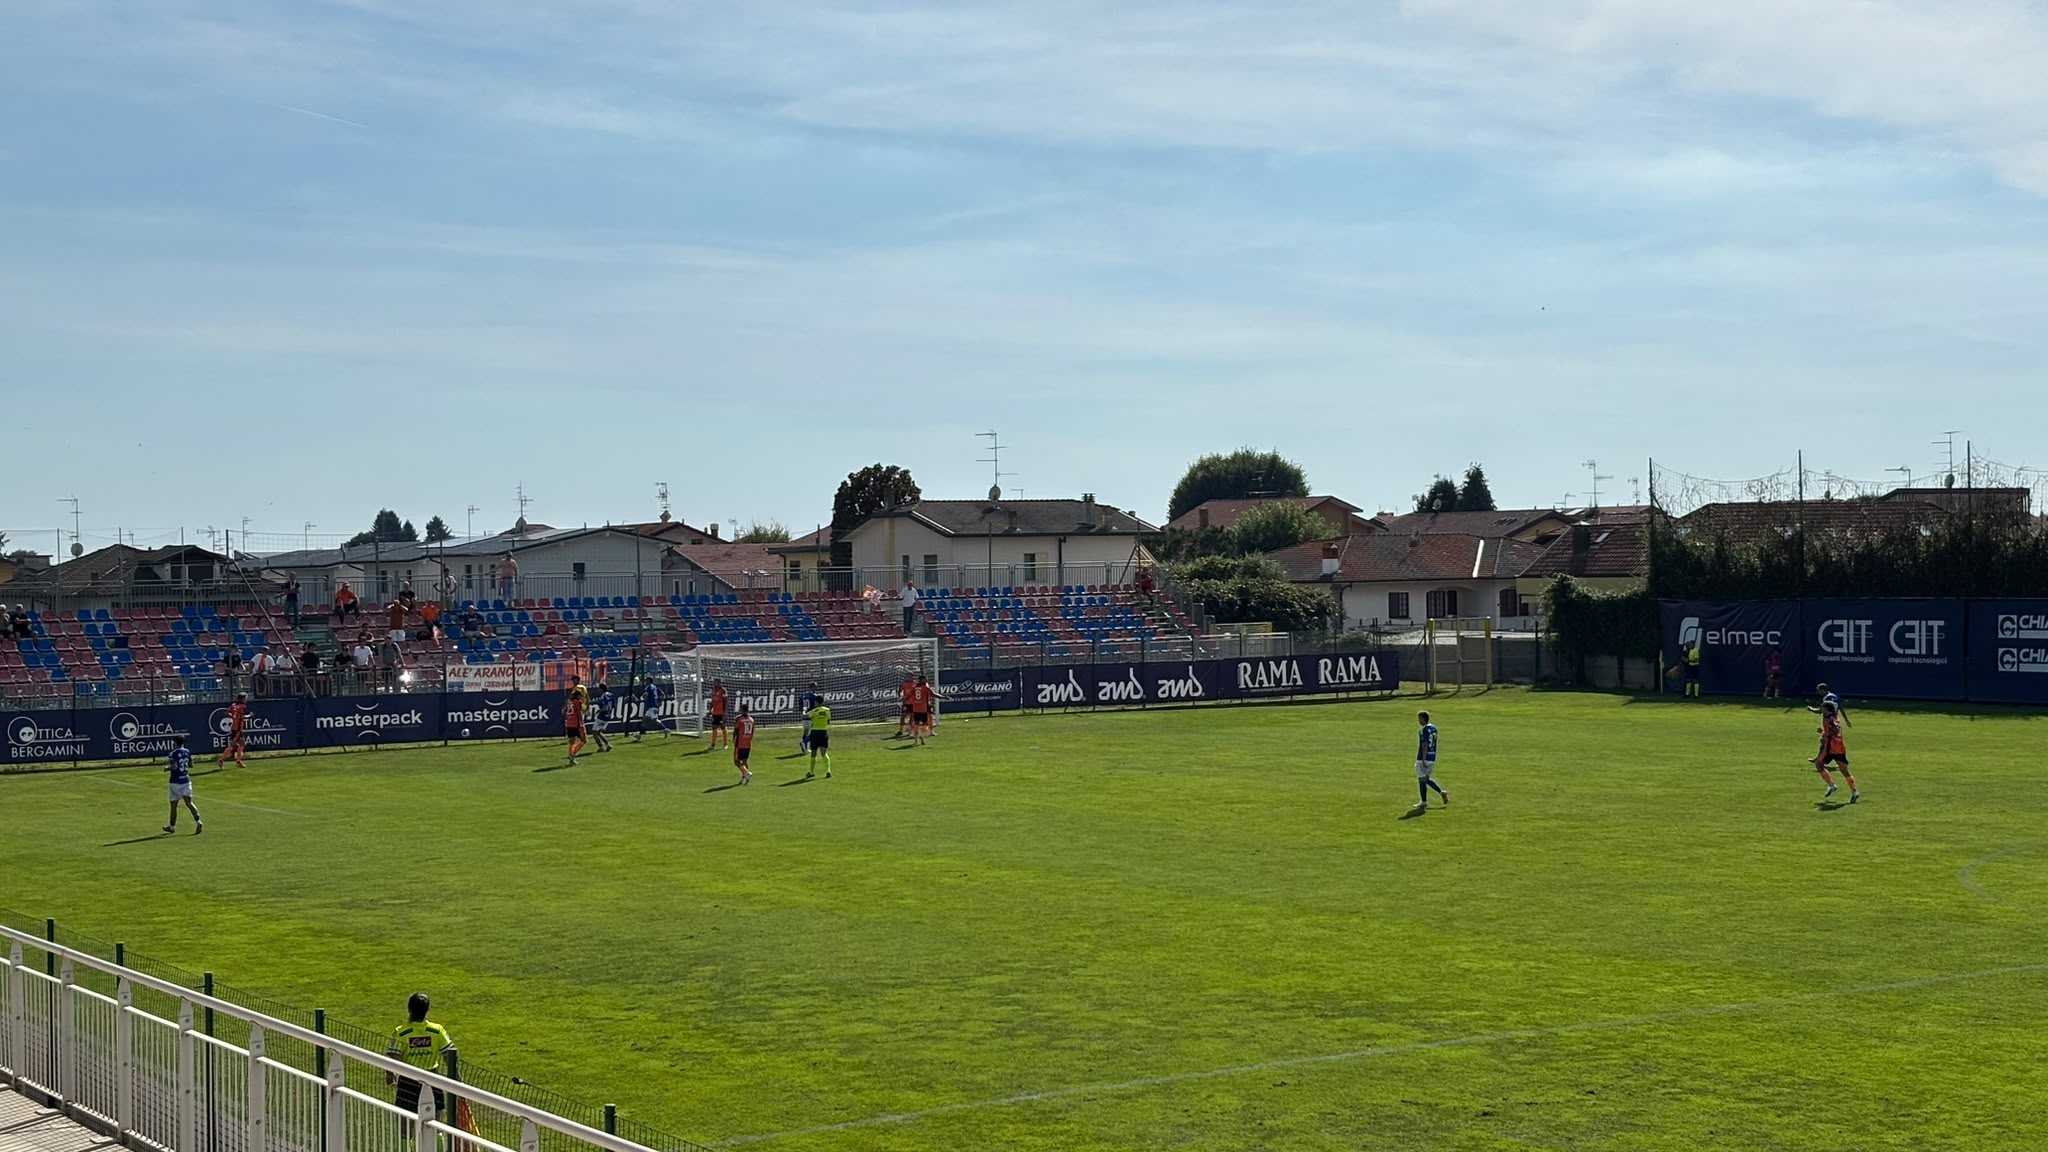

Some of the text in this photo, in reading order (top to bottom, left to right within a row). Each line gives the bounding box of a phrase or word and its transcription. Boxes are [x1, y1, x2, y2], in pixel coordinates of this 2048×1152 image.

[1706, 627, 1781, 645] elmec
[1238, 660, 1303, 688] RAMA
[1319, 655, 1382, 684] RAMA
[735, 688, 795, 714] inalpi
[823, 691, 854, 701] RIVIO
[871, 689, 897, 699] VIGA
[915, 690, 921, 700] 8
[316, 709, 423, 729] masterpack
[447, 705, 549, 724] masterpack
[11, 744, 84, 758] BERGAMINI
[113, 740, 175, 754] BERGAMI
